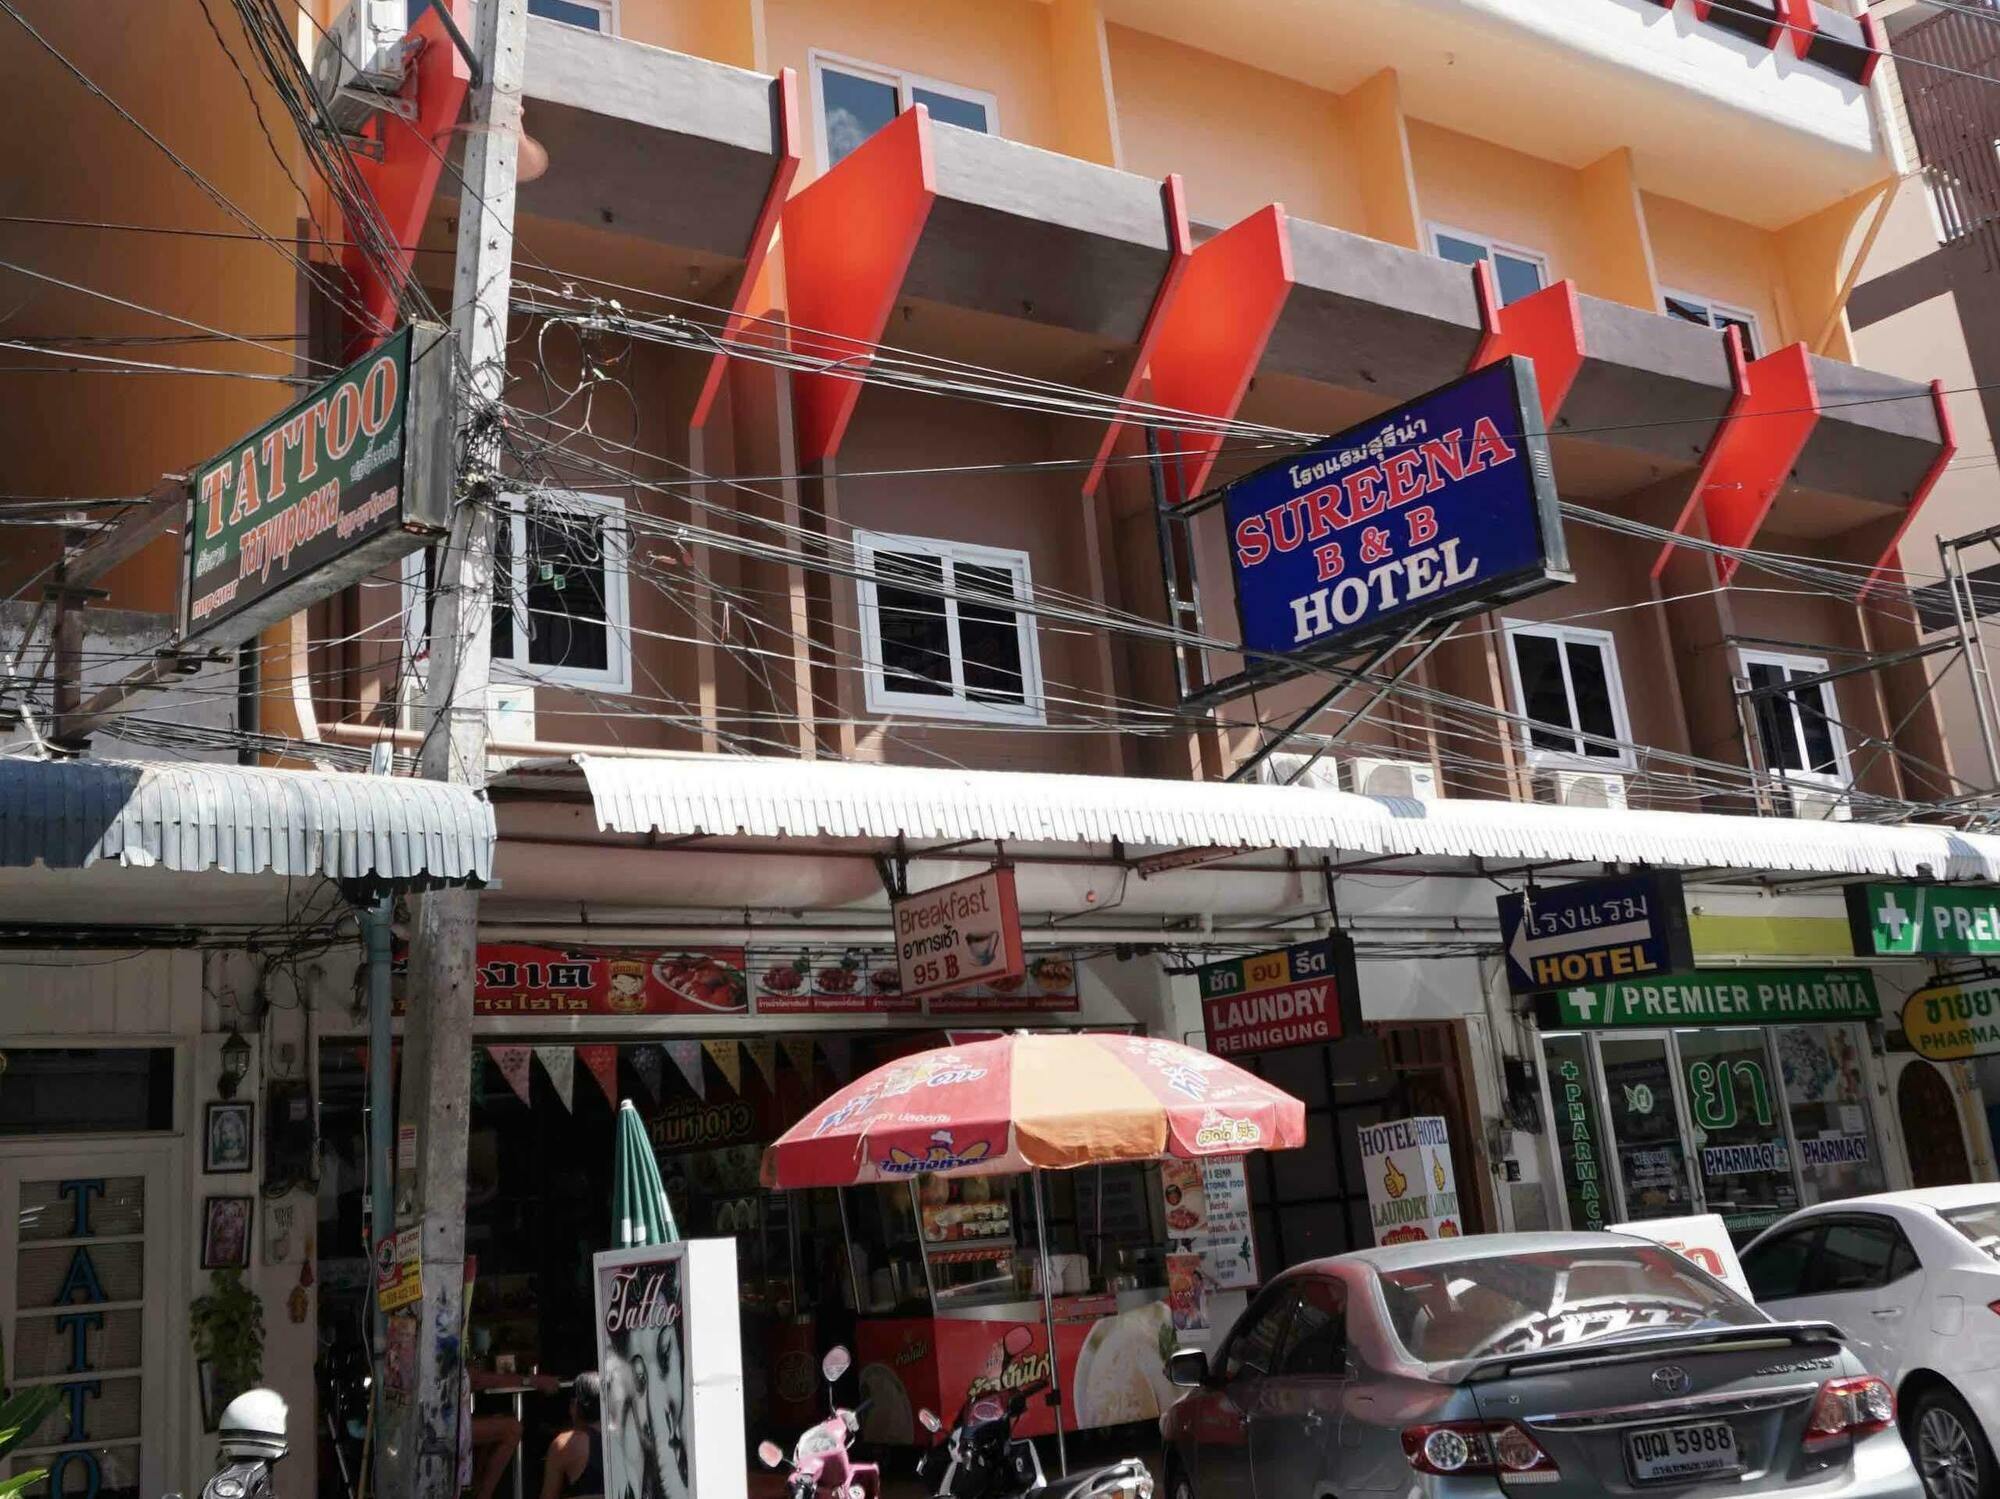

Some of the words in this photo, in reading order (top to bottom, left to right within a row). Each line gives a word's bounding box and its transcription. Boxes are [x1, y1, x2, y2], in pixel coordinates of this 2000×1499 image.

[203, 356, 398, 540] TATTOO
[1236, 416, 1516, 568] SUREENA
[1313, 542, 1345, 582] B
[1360, 526, 1393, 565] &
[1404, 505, 1439, 547] B
[1289, 537, 1479, 644] HOTEL
[900, 883, 990, 936] Breakfast
[1522, 894, 1649, 936] โรงแรม
[913, 961, 940, 985] 95
[1536, 945, 1658, 985] HOTEL
[1211, 985, 1328, 1031] LAUNDRY
[1621, 983, 1750, 1015] PREMIER
[1757, 983, 1871, 1013] PHARMA
[1215, 1020, 1329, 1052] REINIGUNG
[1690, 1060, 1773, 1129] ยา
[1360, 1121, 1417, 1157] HOTEL
[1416, 1119, 1448, 1145] HOTEL
[1802, 1137, 1868, 1166] PHARMACY
[1565, 1083, 1604, 1231] PHARMACY
[1705, 1144, 1776, 1176] PHARMACY
[1372, 1195, 1430, 1227] LAUNDRY
[607, 1268, 682, 1334] Tattoo
[1674, 1427, 1732, 1455] 5988
